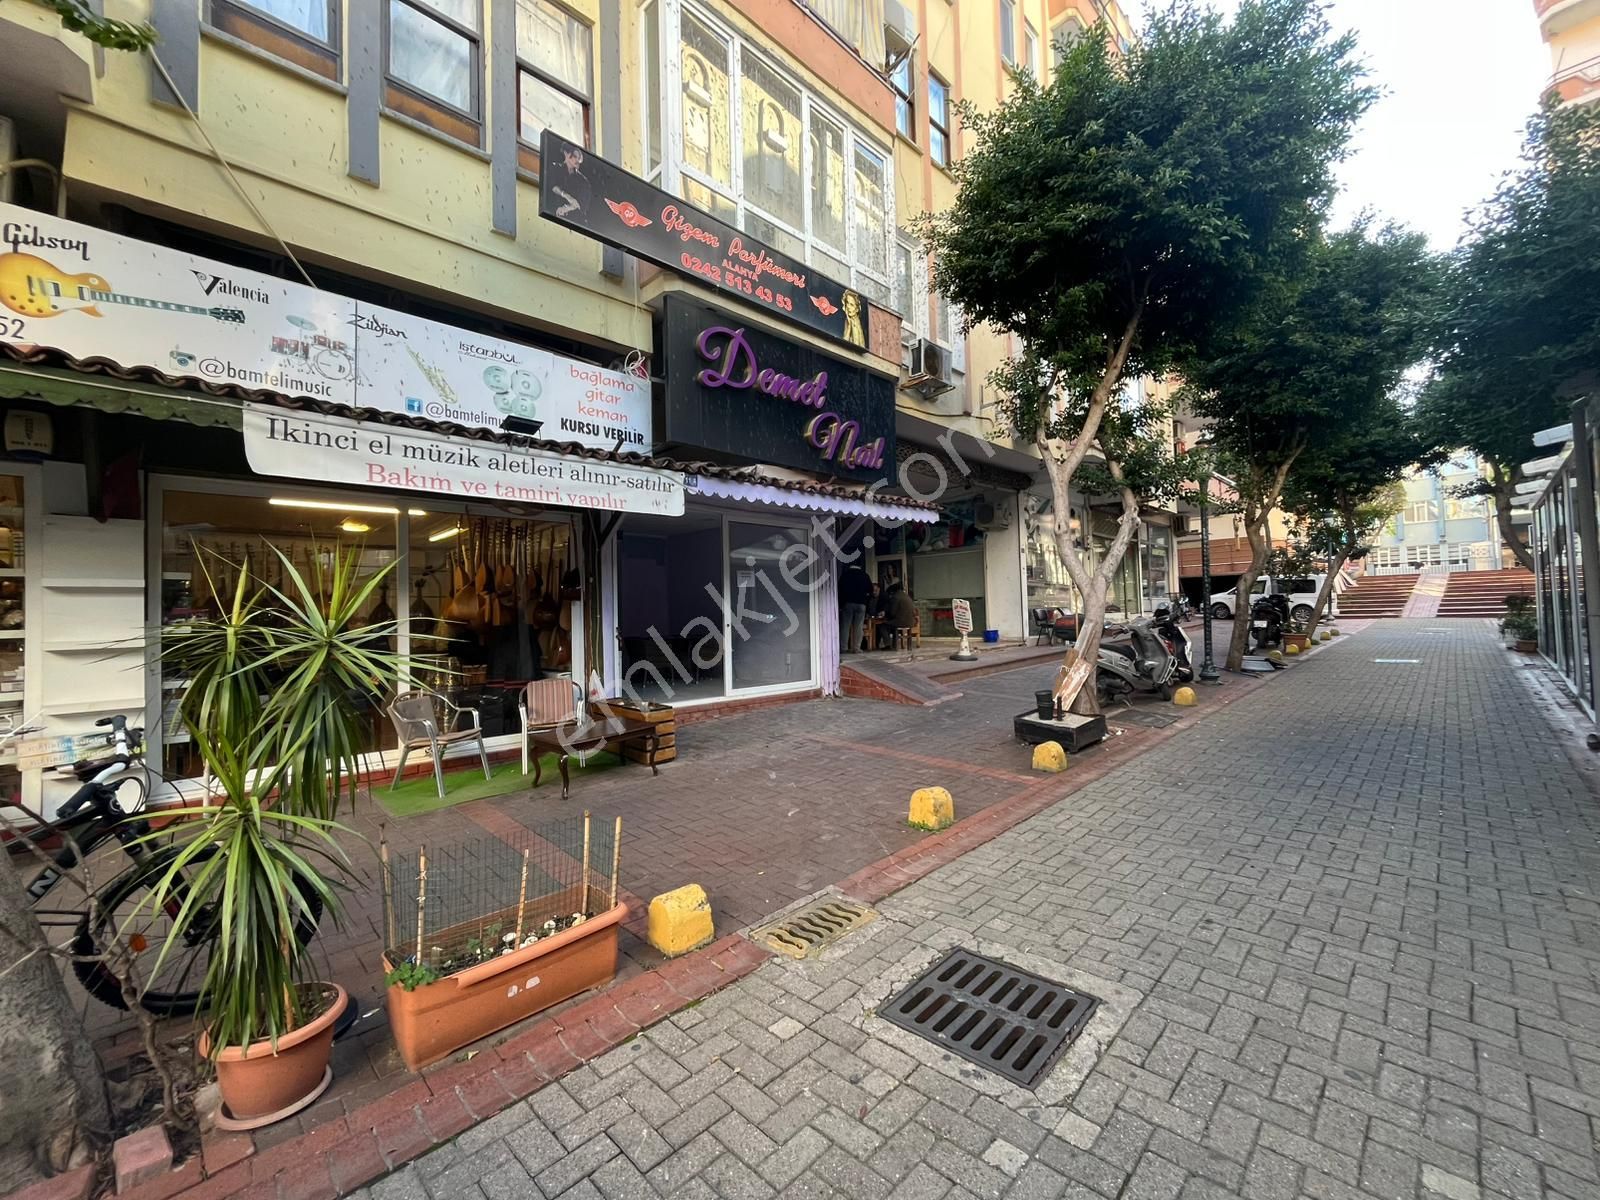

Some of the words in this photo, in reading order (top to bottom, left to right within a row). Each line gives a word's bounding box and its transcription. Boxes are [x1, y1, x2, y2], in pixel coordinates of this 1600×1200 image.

[3, 222, 90, 261] Gibson
[681, 252, 721, 282] 0242
[725, 272, 752, 294] 513
[755, 285, 773, 303] 43
[775, 293, 793, 312] 53
[728, 237, 806, 288] Parfümeri
[189, 269, 270, 304] Valencia
[346, 313, 408, 339] Zildjian
[198, 358, 333, 397] @bamtelimusic
[569, 364, 635, 392] bağlama
[697, 326, 828, 409] Demet
[578, 401, 628, 423] keman
[585, 388, 621, 405] gitar
[561, 418, 599, 436] KURSU
[603, 426, 644, 445] VERİLİR
[804, 411, 885, 470] Nail
[369, 436, 393, 456] el
[402, 442, 480, 468] müzik
[488, 454, 563, 479] aletleri
[570, 465, 675, 493] alınır-satılır
[366, 462, 452, 492] Bakım
[461, 479, 487, 494] ve
[495, 480, 561, 502] tamiri
[567, 493, 627, 510] yapılır
